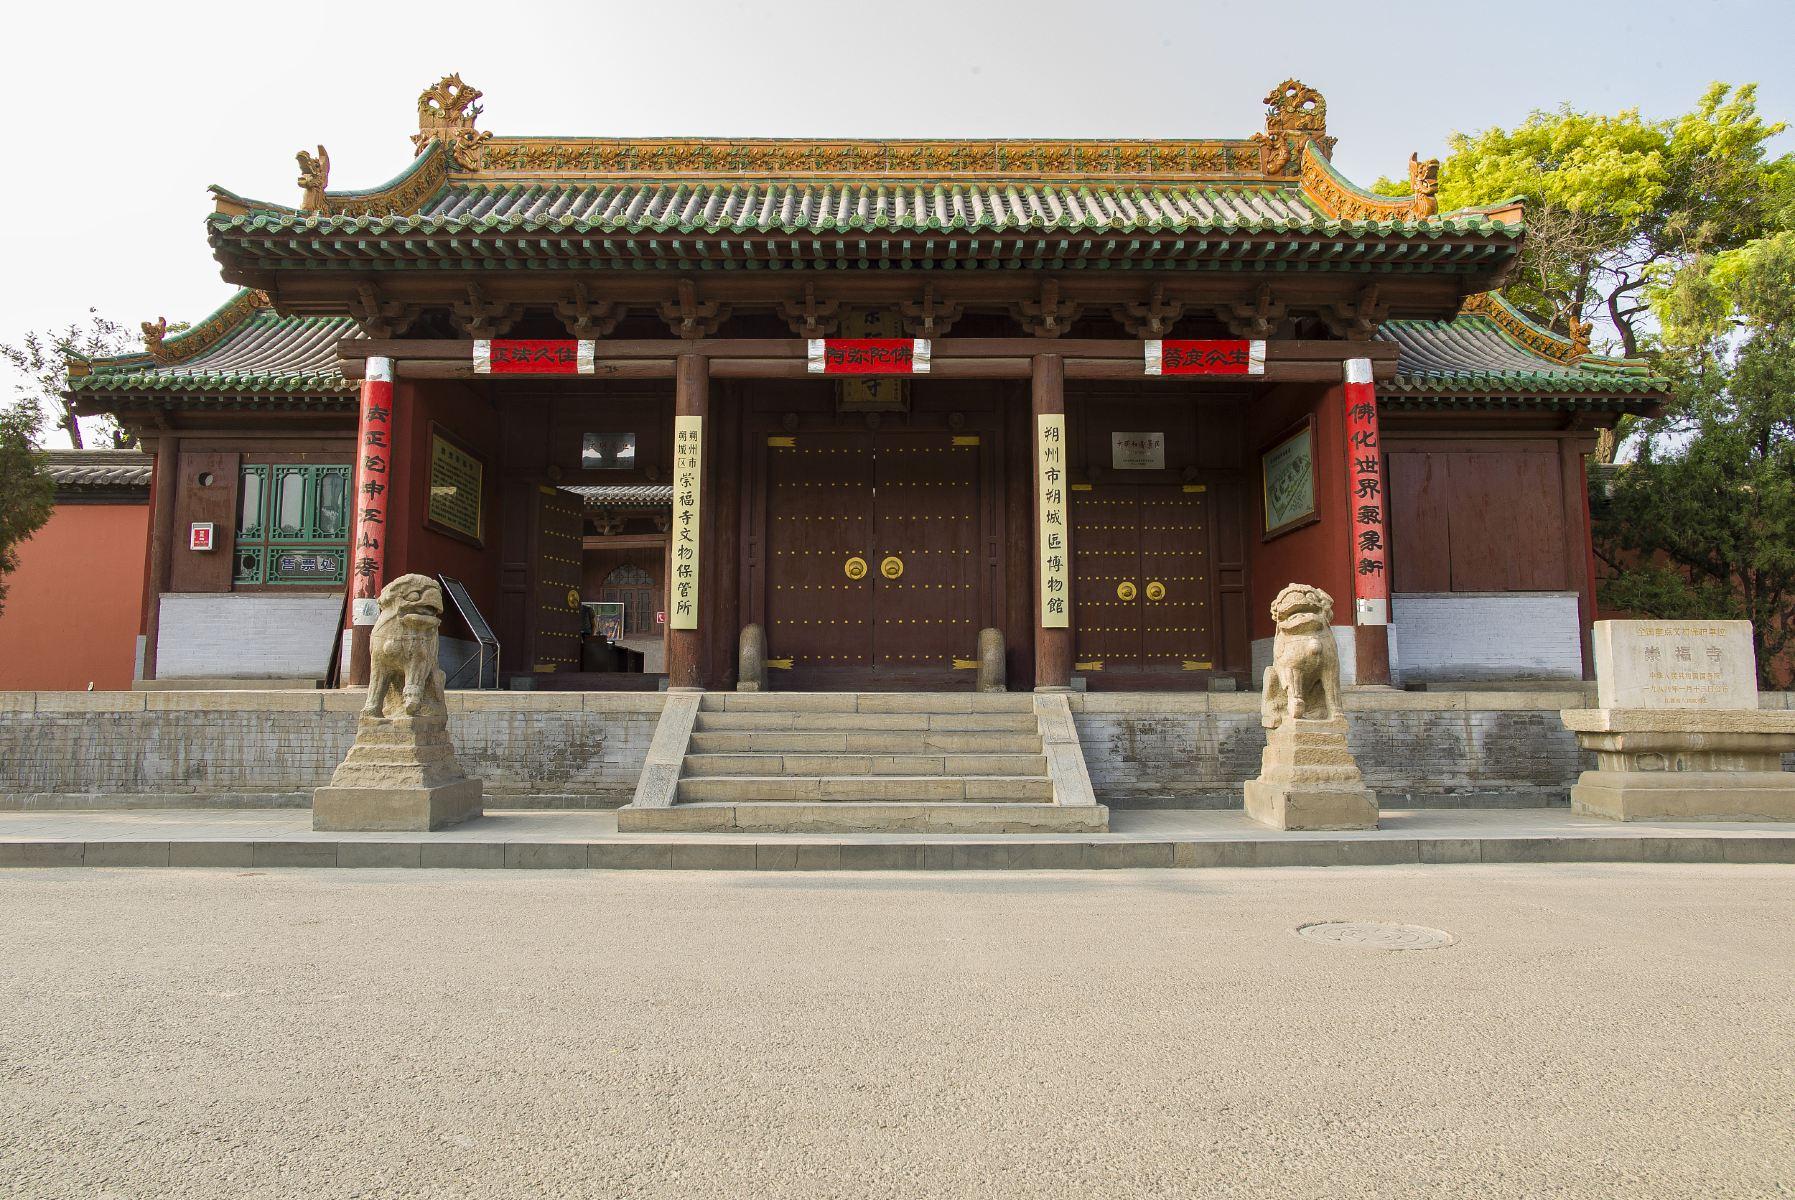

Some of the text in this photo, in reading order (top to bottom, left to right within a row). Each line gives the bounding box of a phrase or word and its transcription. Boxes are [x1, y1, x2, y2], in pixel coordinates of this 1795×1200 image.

[281, 557, 336, 571] 售票处
[1644, 645, 1723, 663] 崇福寺
